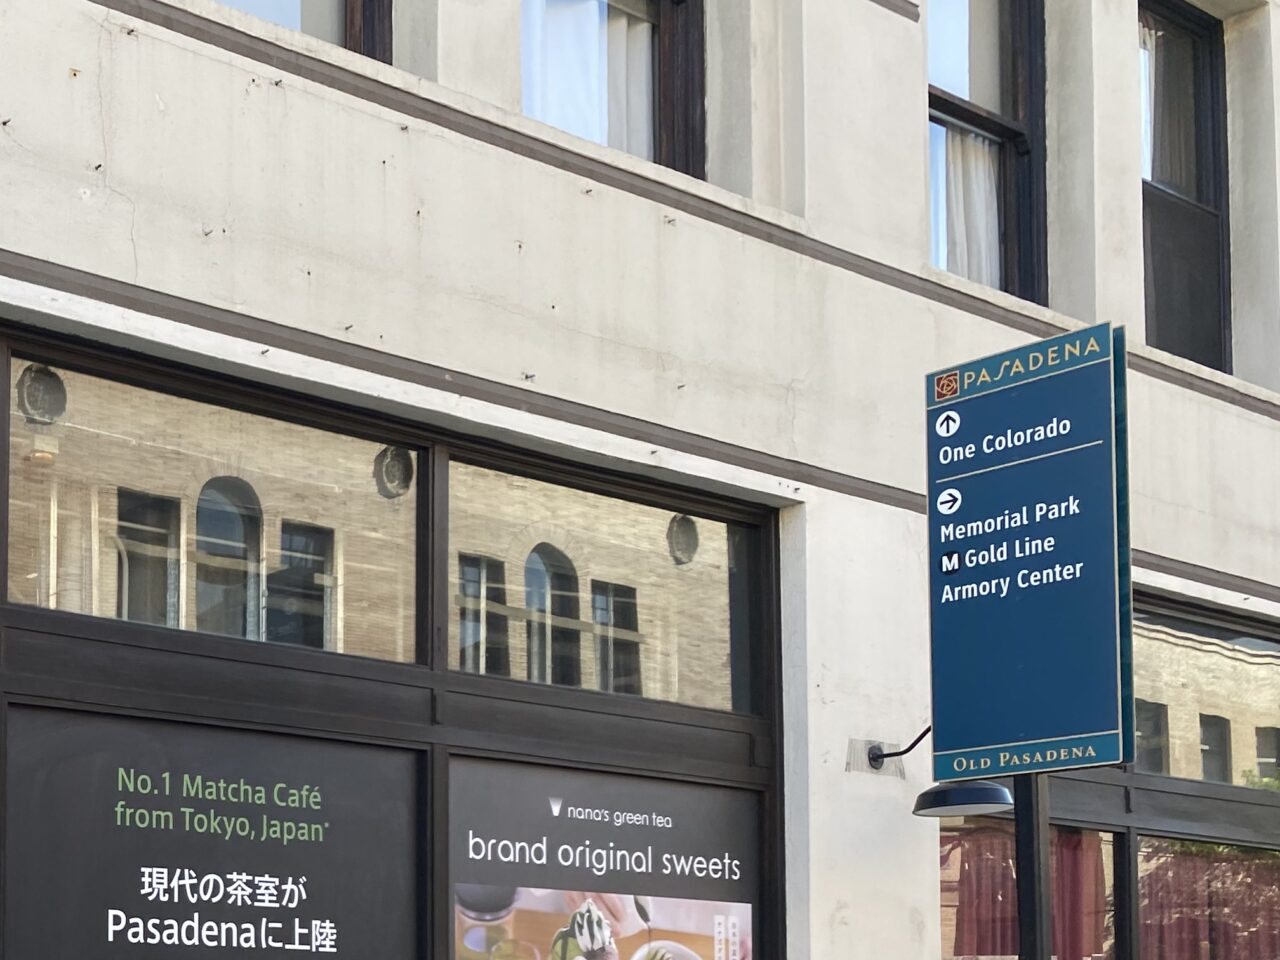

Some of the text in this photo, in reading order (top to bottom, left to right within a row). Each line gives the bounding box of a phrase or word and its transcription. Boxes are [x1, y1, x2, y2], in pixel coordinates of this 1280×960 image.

[963, 337, 1100, 389] PASADENA
[939, 418, 1071, 466] One Colorado
[940, 495, 1080, 542] Memorial Park
[941, 536, 1055, 572] M Gold Line
[941, 562, 1084, 603] Armory Center
[118, 767, 322, 809] No.1 Matcha Café
[114, 801, 174, 830] from
[181, 807, 255, 841] Tokyo,
[568, 806, 672, 828] nana's green tea
[469, 830, 741, 880] brand original sweets
[140, 866, 307, 908] 現代の茶室が
[107, 909, 337, 953] Pasadenaに上陸
